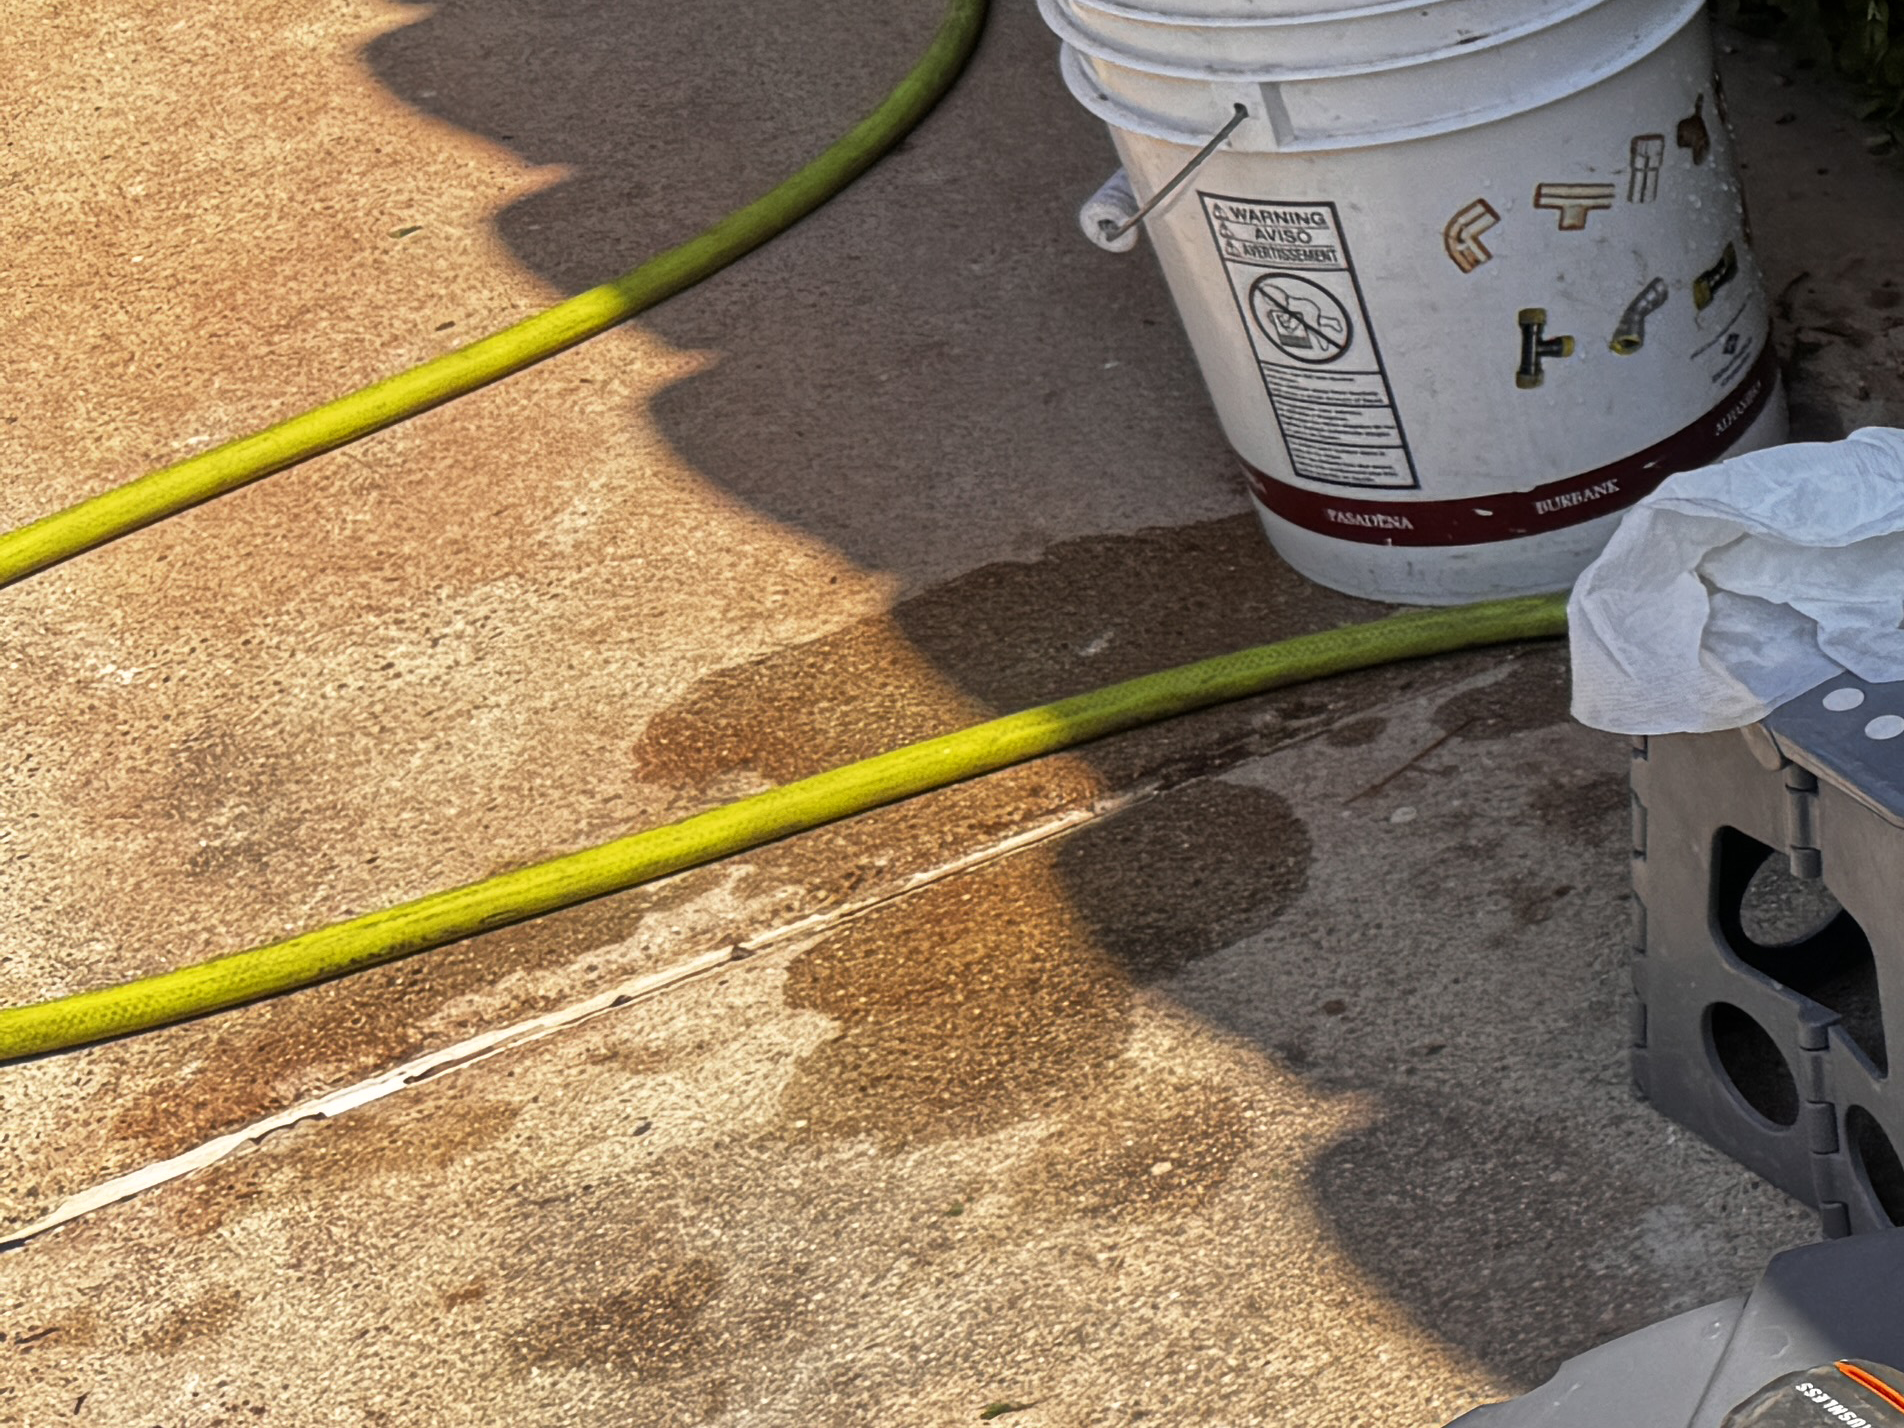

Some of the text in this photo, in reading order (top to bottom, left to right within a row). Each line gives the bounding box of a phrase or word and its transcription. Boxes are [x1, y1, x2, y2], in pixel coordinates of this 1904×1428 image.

[1229, 205, 1326, 226] WARNING
[1254, 227, 1313, 244] AVISO
[1242, 243, 1339, 263] AVERTISSEMENT
[1534, 479, 1621, 515] BURBANK
[1327, 508, 1414, 530] PASADENA
